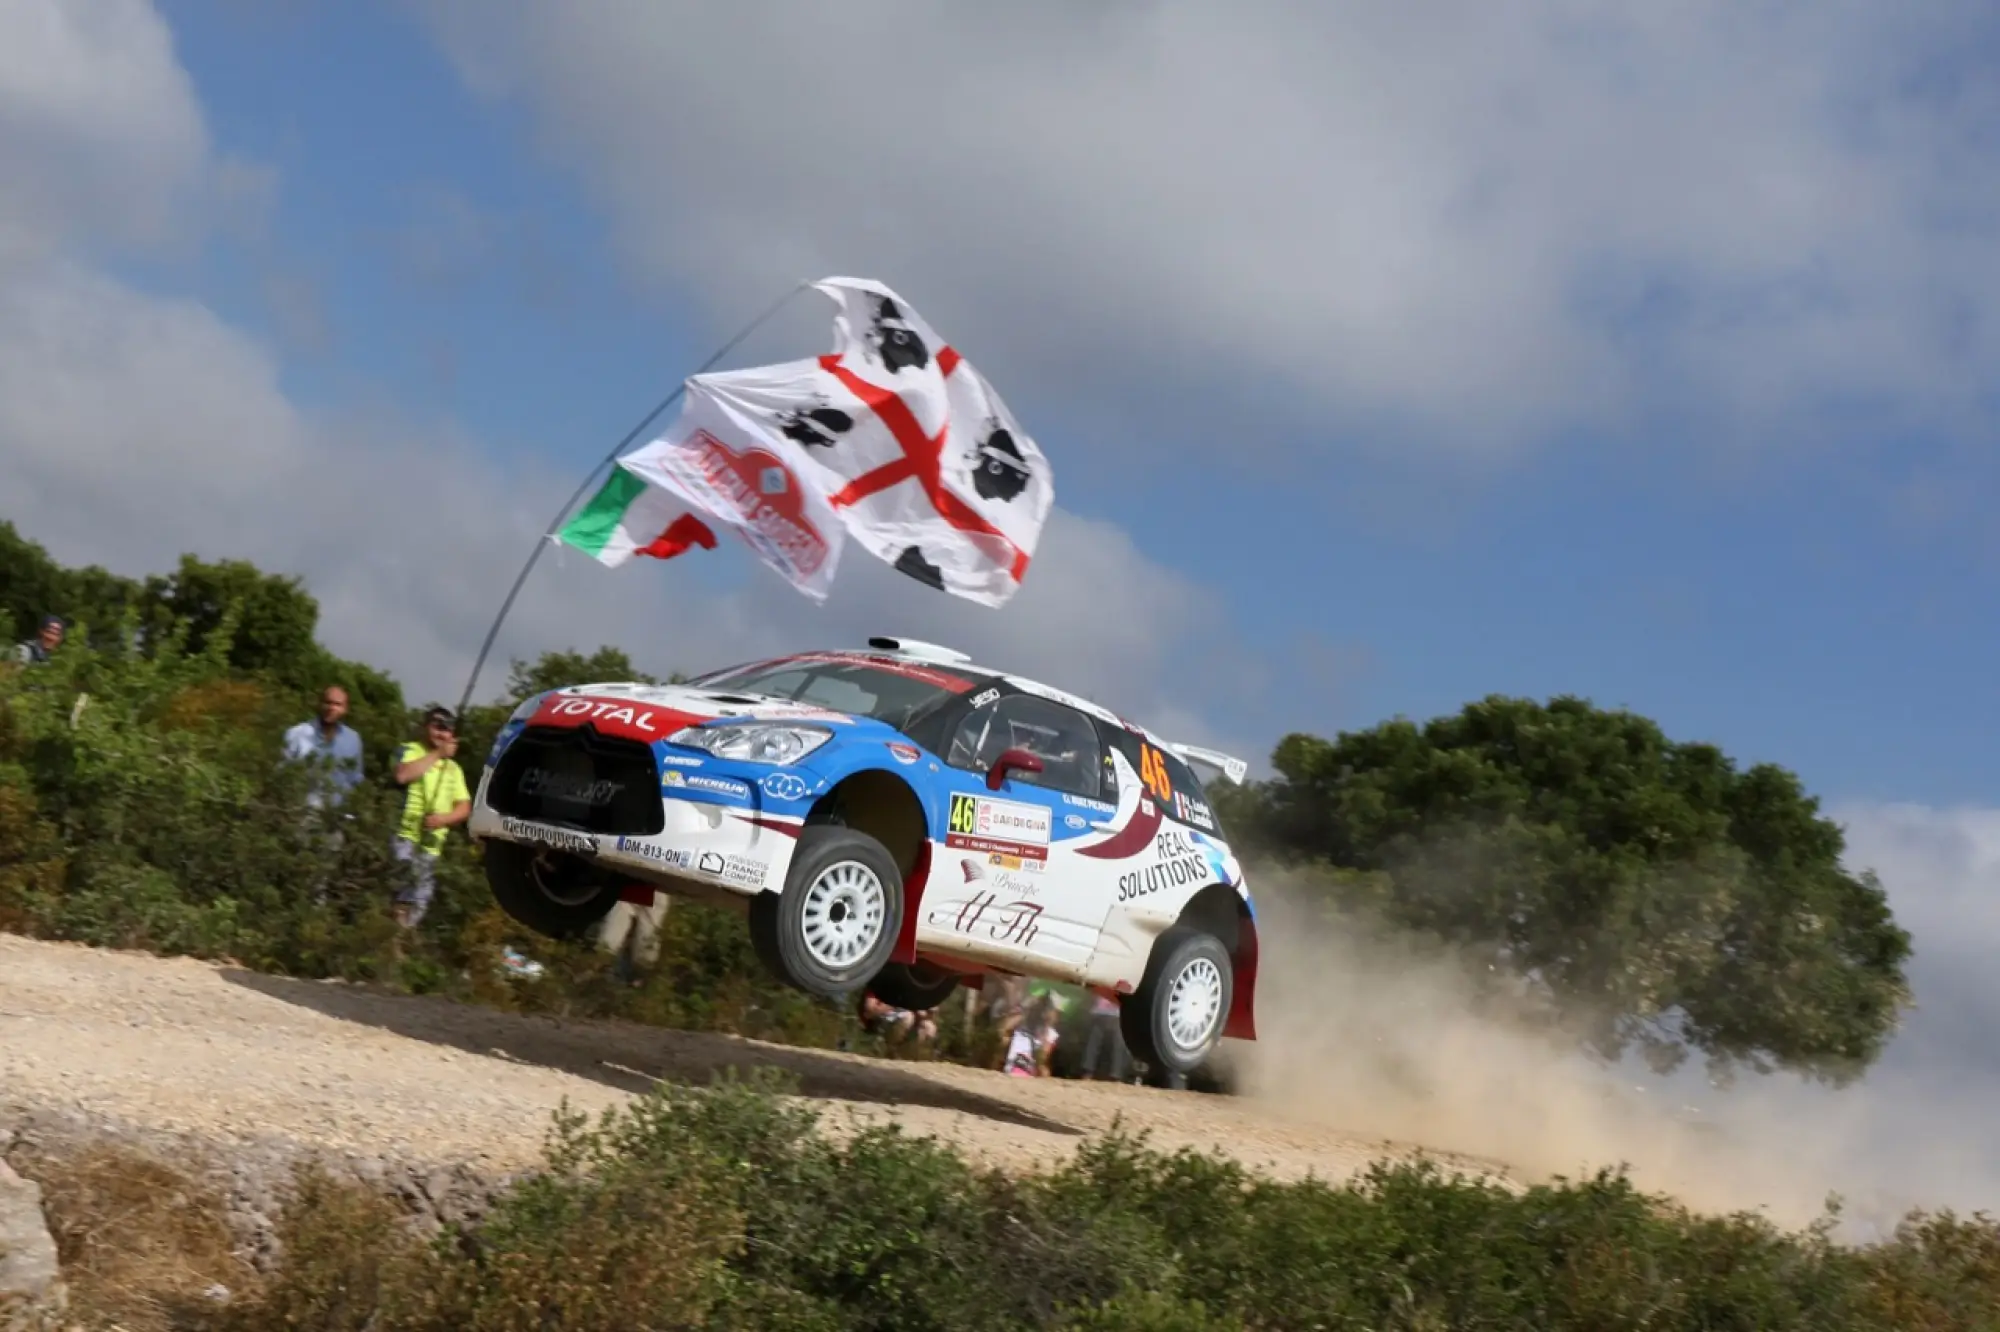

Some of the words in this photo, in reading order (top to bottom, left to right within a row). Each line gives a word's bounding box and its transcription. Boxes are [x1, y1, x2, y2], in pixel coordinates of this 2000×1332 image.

[551, 698, 656, 732] TOTAL
[688, 776, 744, 793] MICHELIN
[1141, 743, 1172, 801] 46
[951, 796, 973, 833] 46
[1157, 831, 1196, 860] REAL
[726, 862, 764, 877] FRANCE
[1118, 854, 1208, 902] SOLUTIONS
